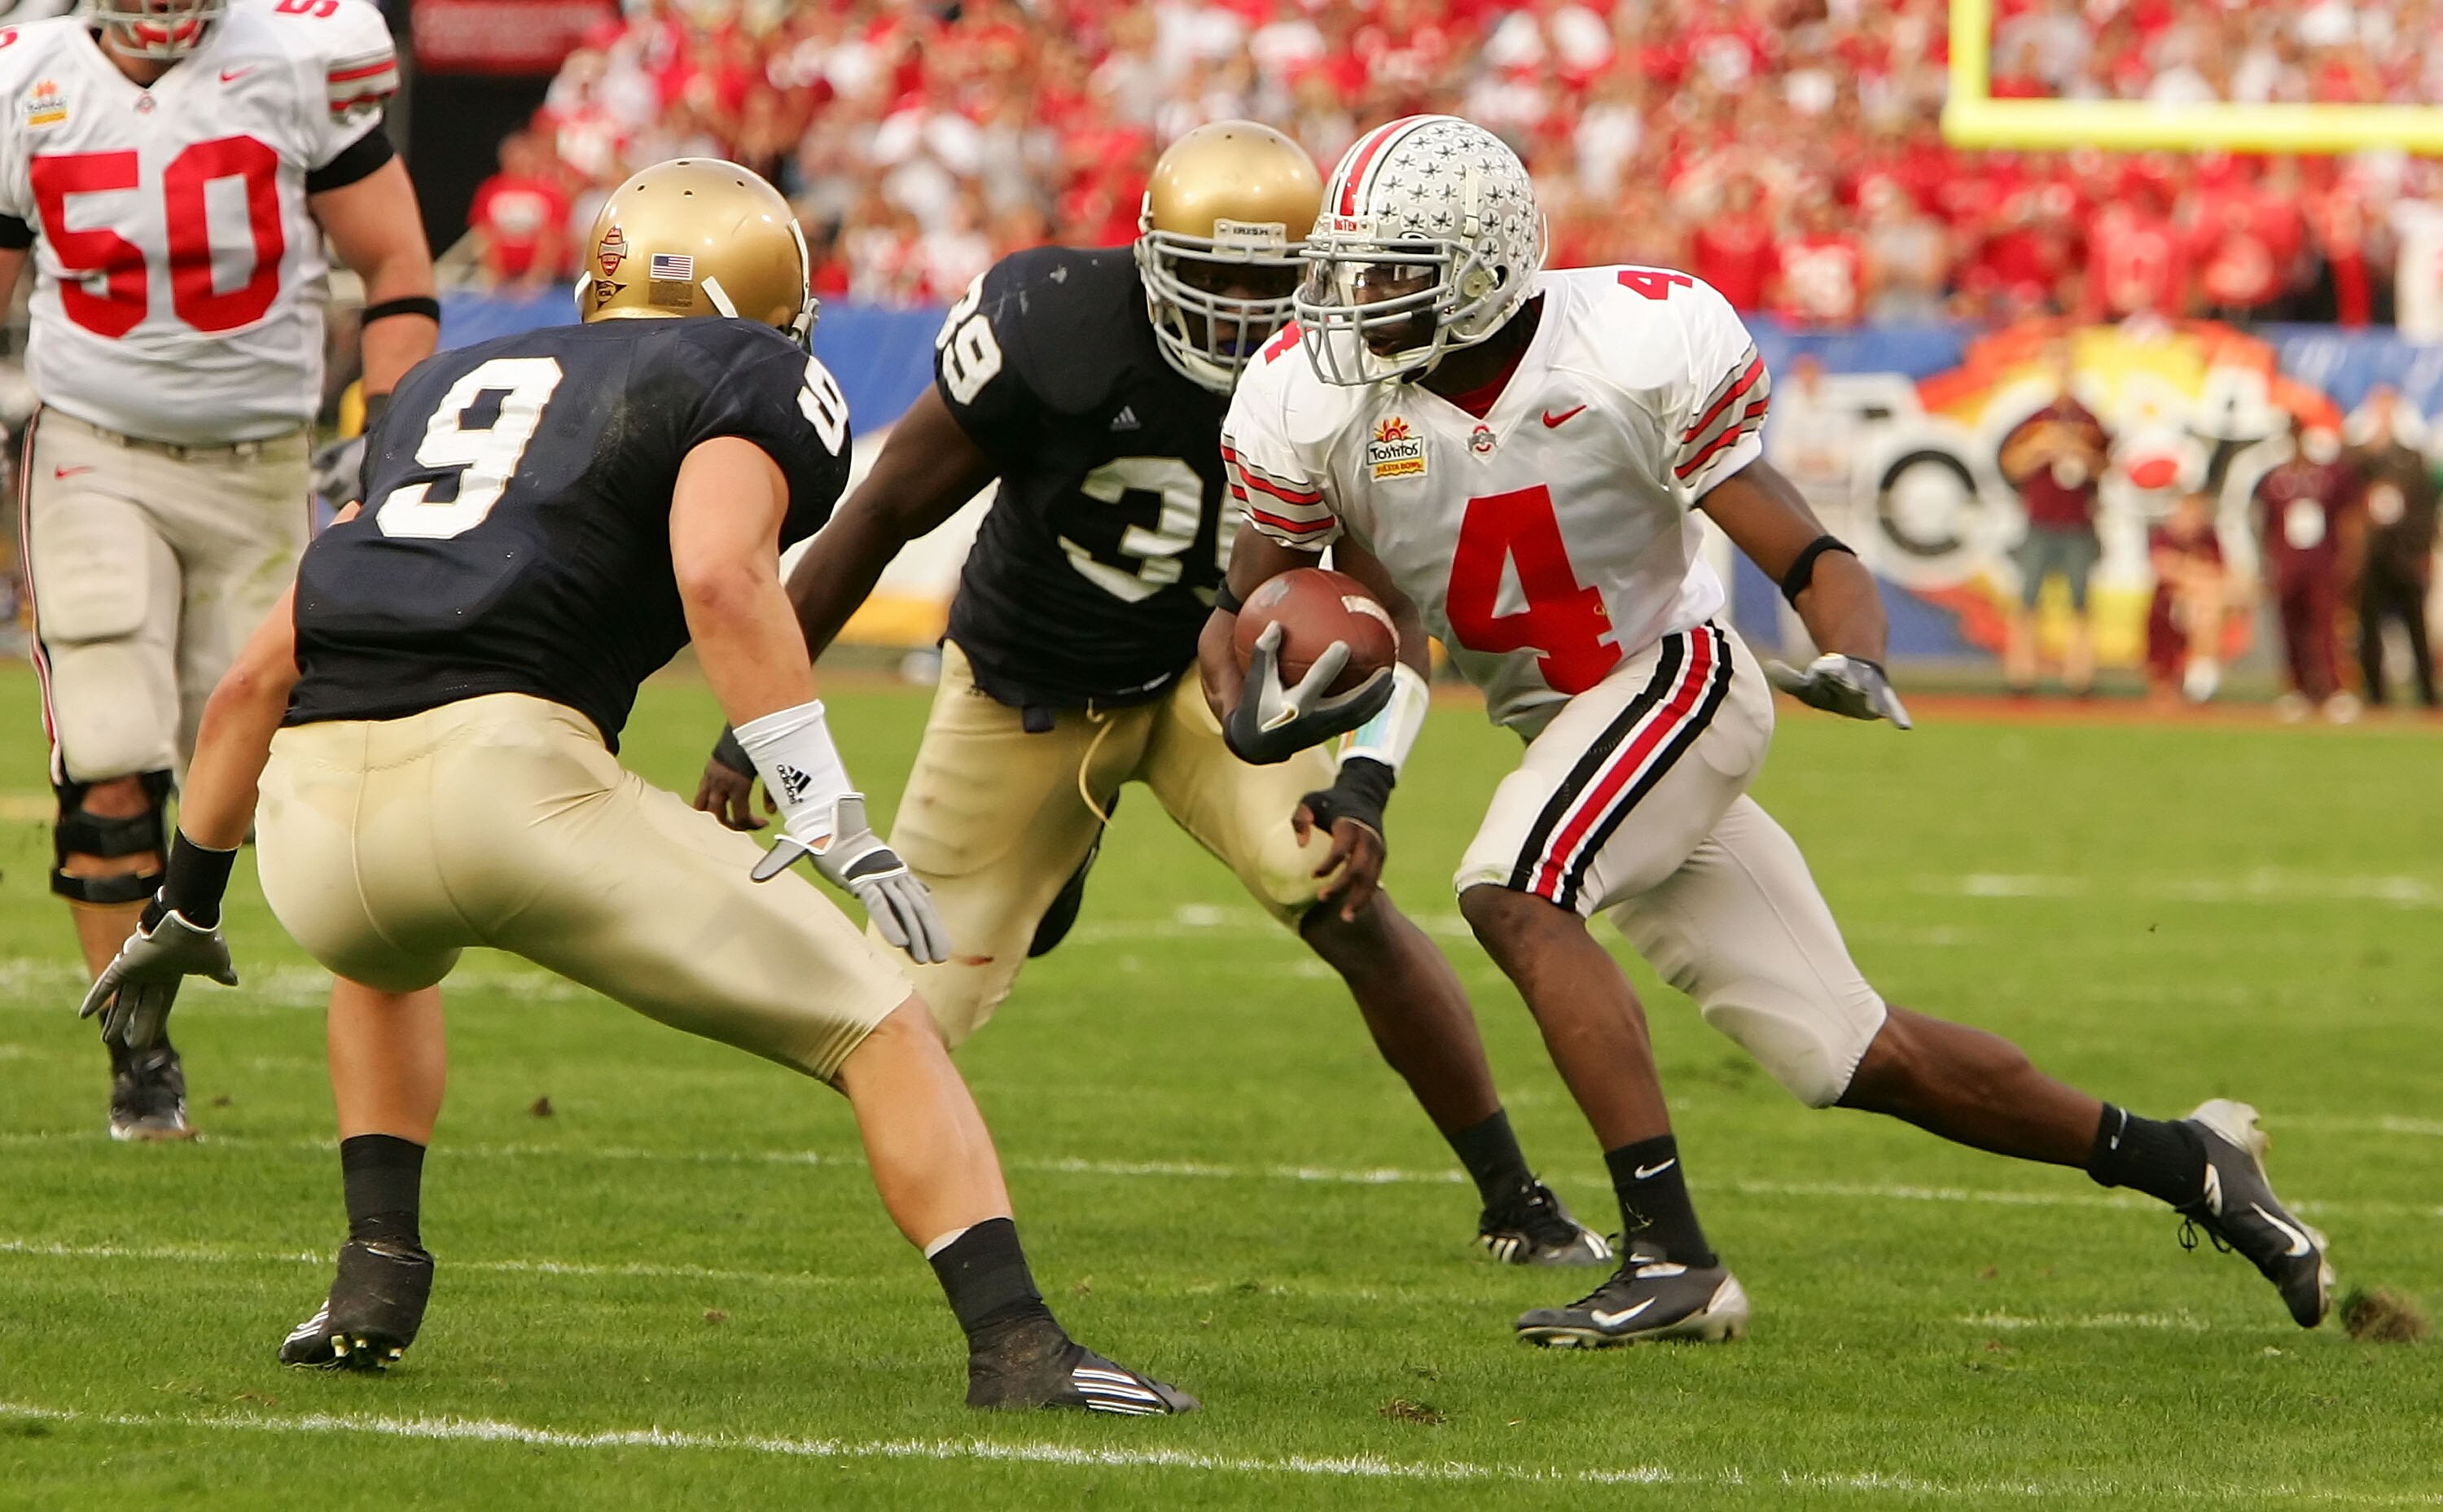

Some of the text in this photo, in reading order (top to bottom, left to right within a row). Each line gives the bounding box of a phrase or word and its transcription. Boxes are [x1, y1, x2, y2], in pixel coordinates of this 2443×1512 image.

[30, 134, 283, 339] 50
[1233, 226, 1269, 235] IRISH
[1618, 270, 1692, 300] 4
[375, 356, 563, 540] 9
[1445, 484, 1623, 696] 4
[776, 764, 798, 805] adidas
